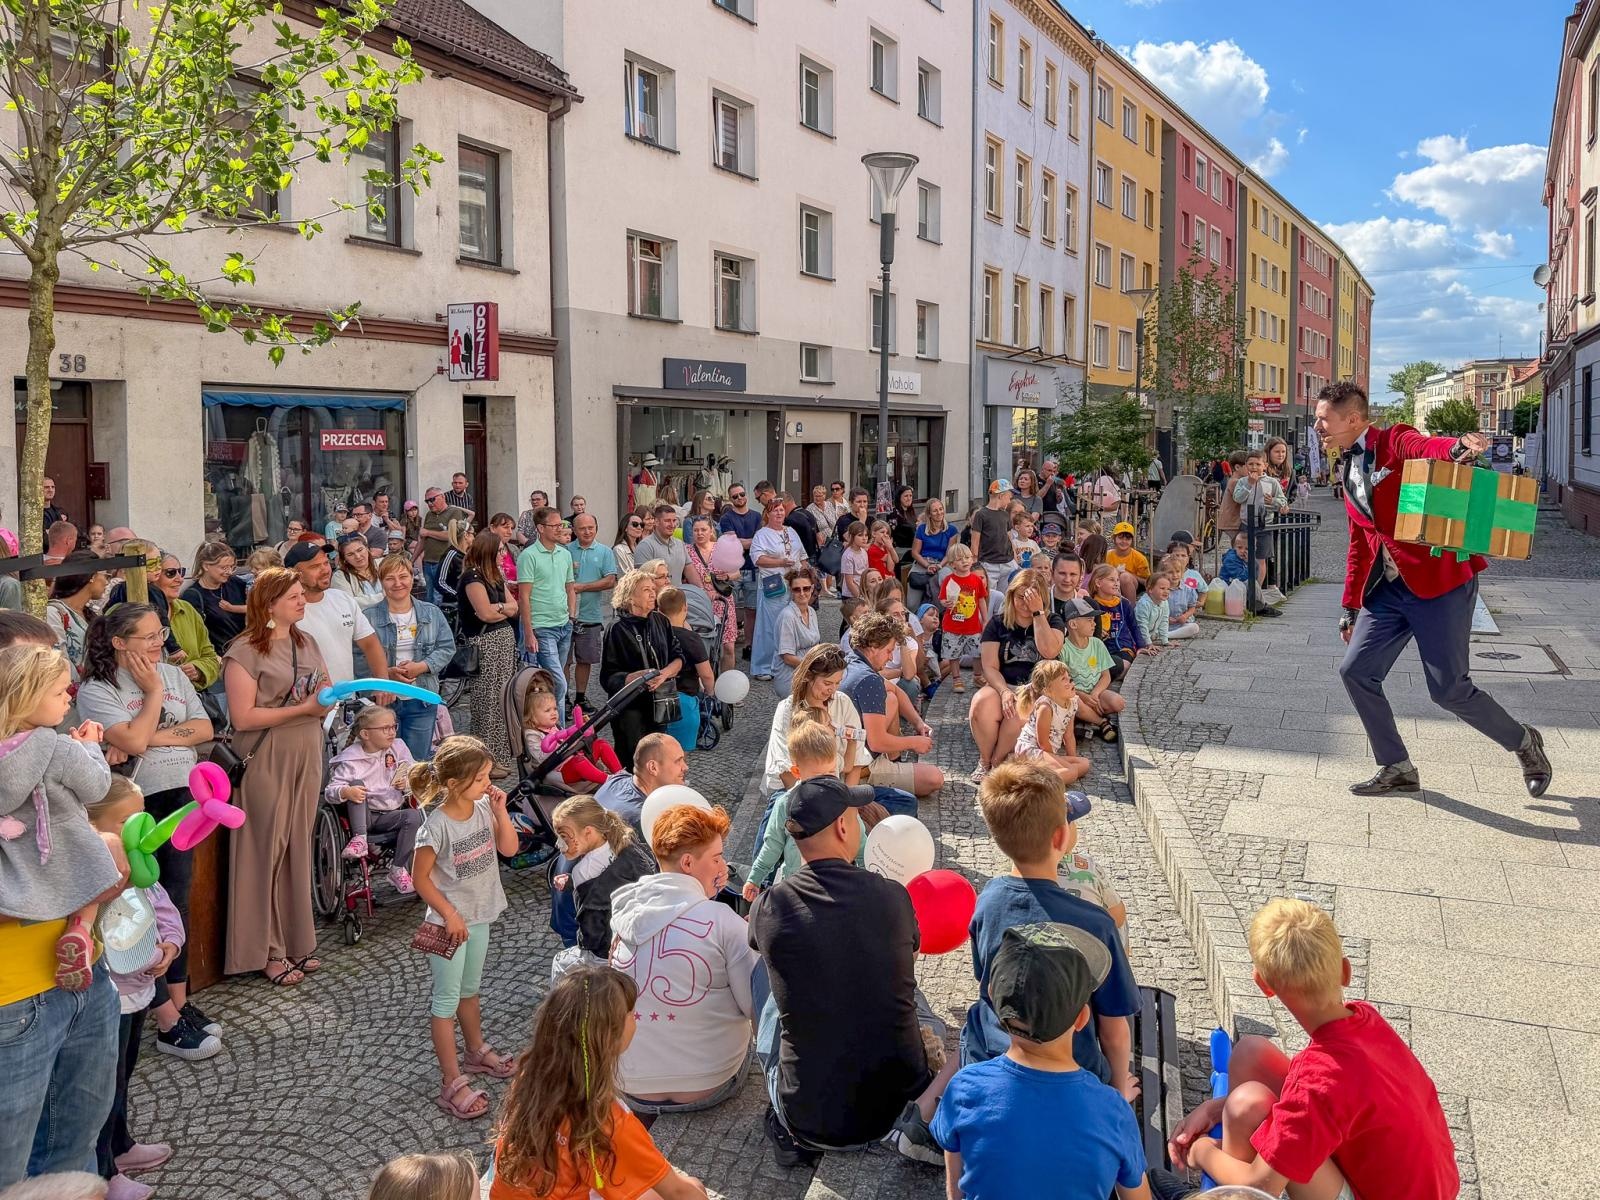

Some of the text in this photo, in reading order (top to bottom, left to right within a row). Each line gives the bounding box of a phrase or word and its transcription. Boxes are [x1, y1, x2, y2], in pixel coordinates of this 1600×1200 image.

[59, 354, 86, 373] 38
[683, 364, 732, 386] Valentina
[322, 434, 384, 446] PRZECENA
